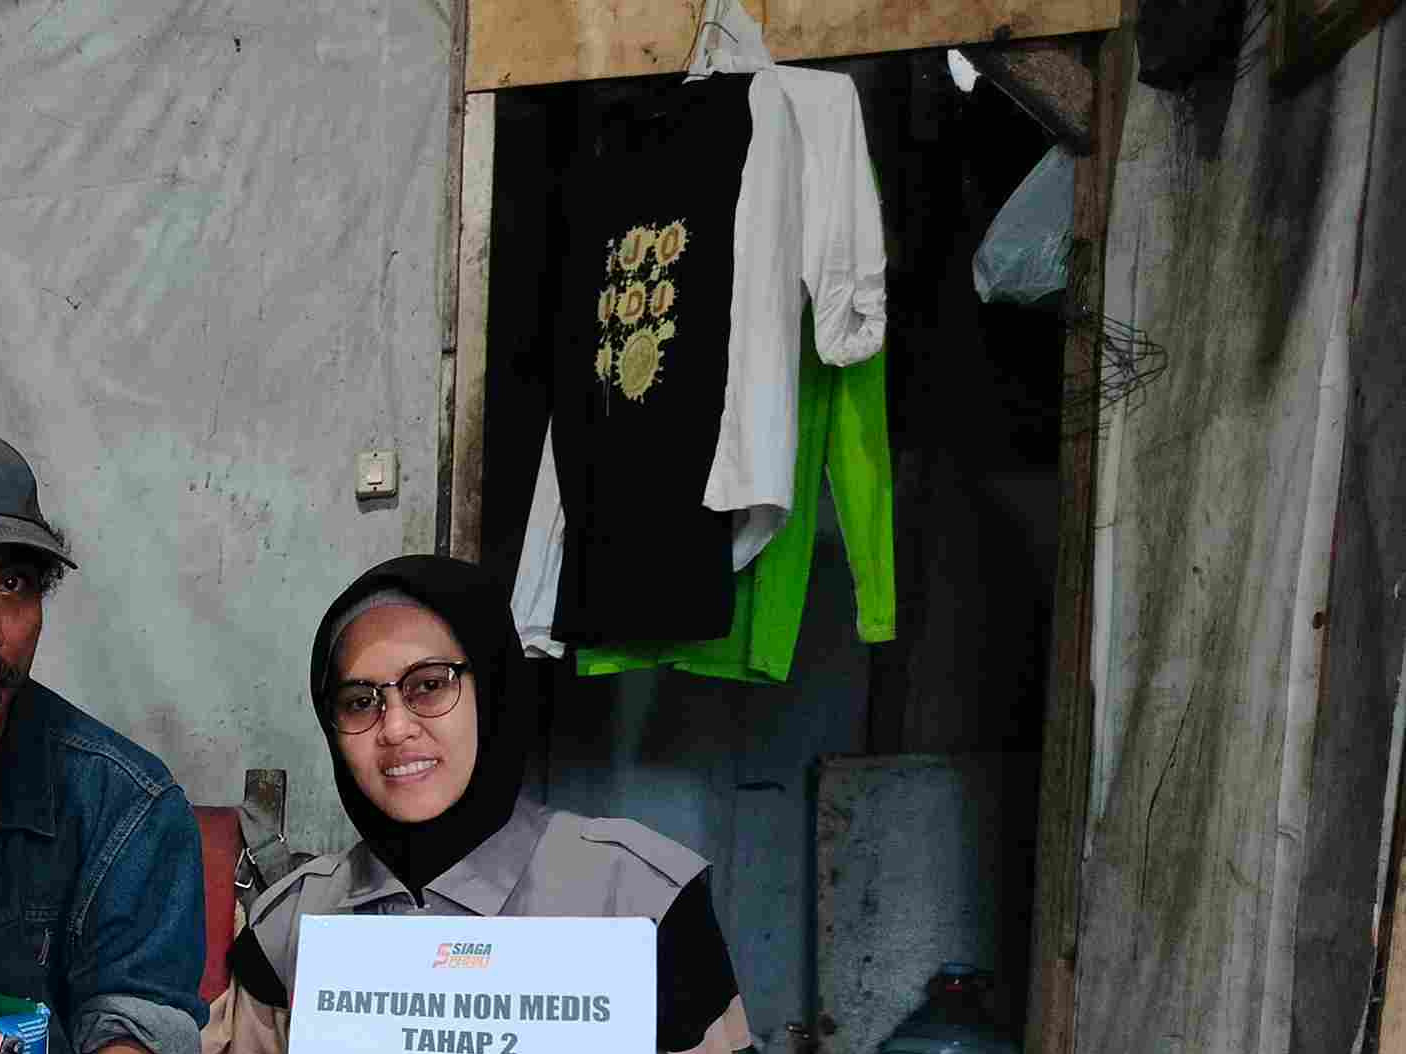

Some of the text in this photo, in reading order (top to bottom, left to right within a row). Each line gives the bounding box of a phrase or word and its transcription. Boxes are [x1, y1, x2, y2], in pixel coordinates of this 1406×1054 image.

[451, 943, 492, 955] SIAGA
[317, 990, 610, 1022] BANTUAN NON MEDIS
